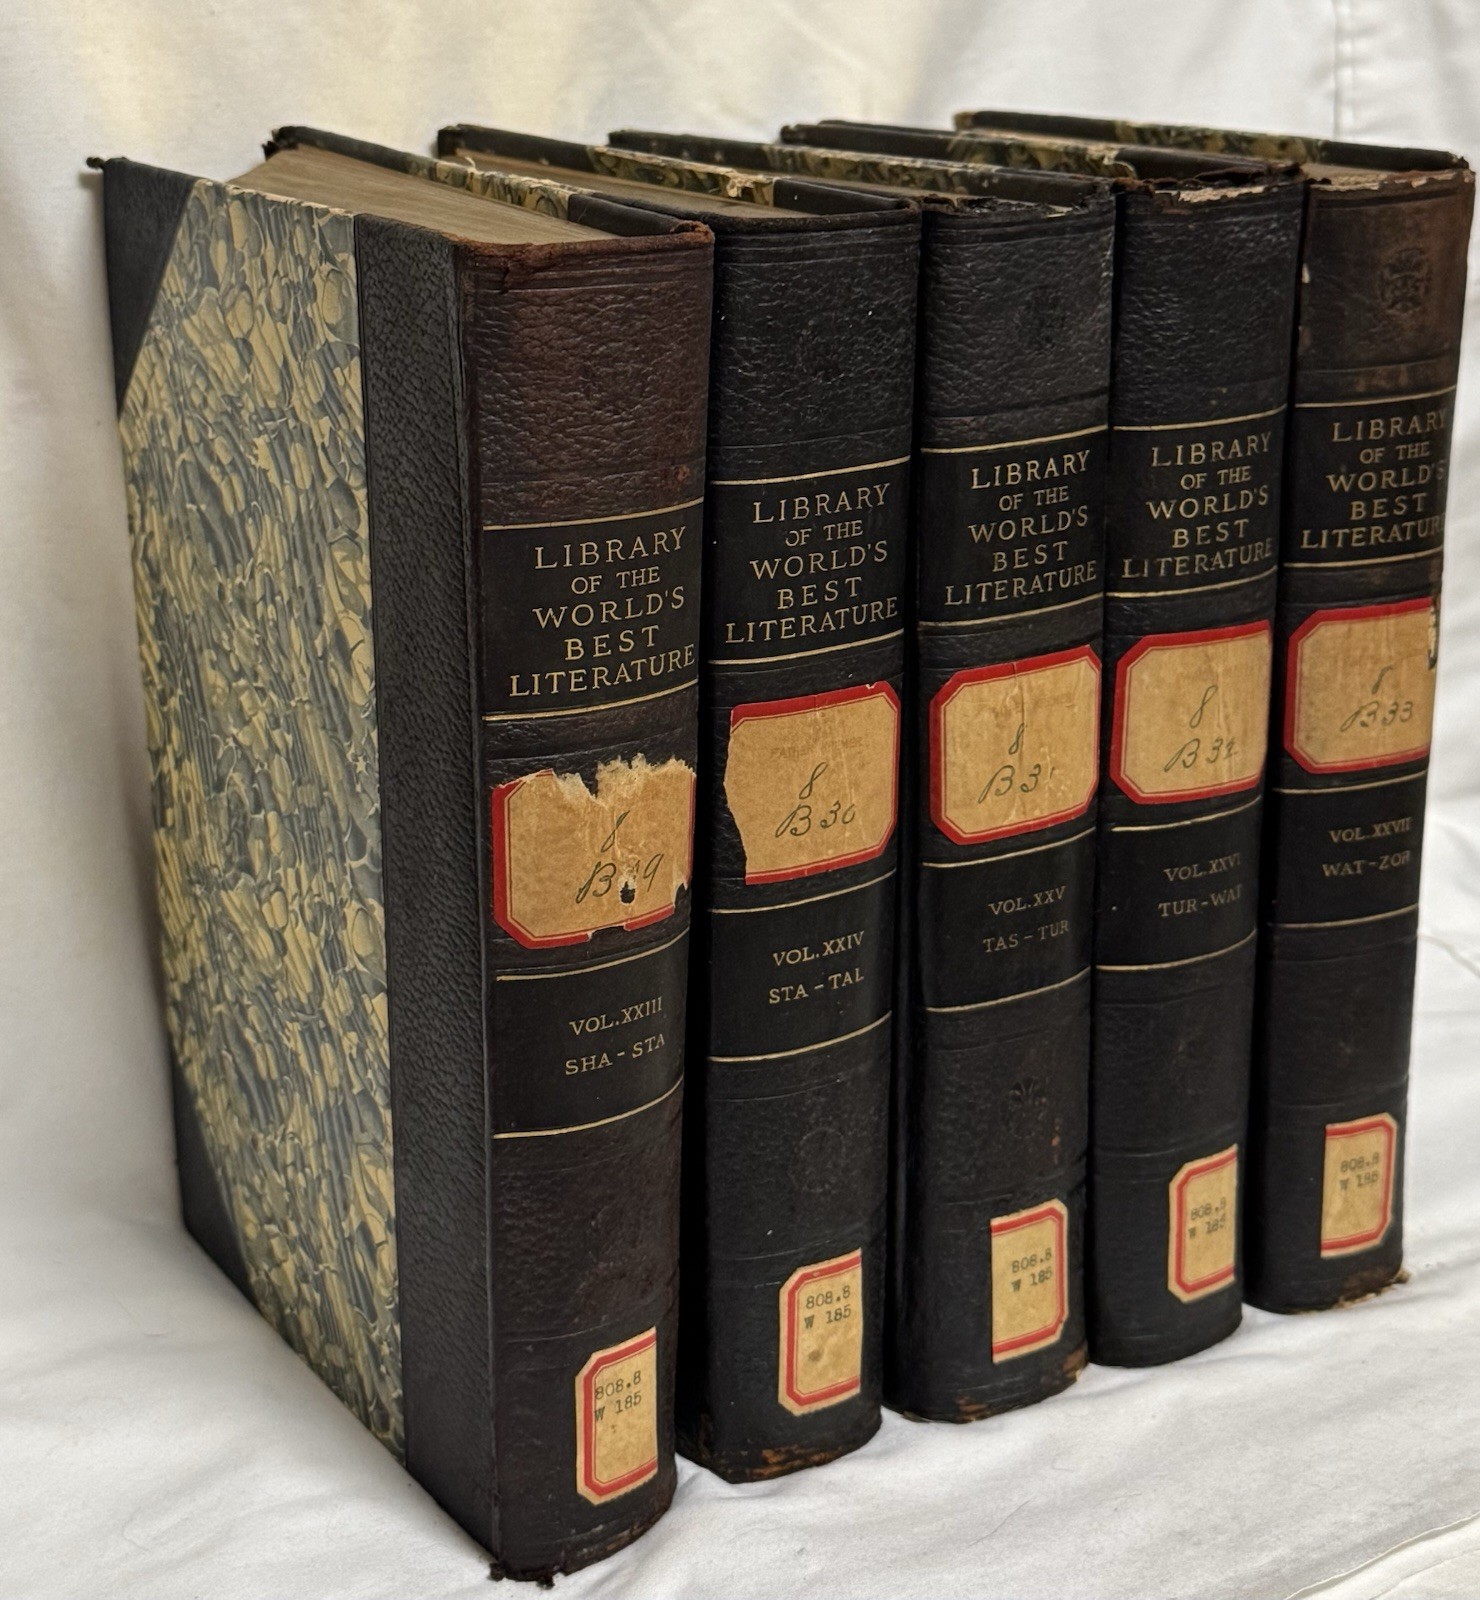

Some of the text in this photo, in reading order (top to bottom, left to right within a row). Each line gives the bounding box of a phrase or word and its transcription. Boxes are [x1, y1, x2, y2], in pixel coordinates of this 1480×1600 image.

[1331, 407, 1449, 443] LIBRARY
[1151, 431, 1272, 467] LIBRARY
[1359, 441, 1431, 465] OF THE
[970, 449, 1090, 490] LIBRARY
[1180, 465, 1252, 490] OF THE
[1326, 459, 1446, 493] WORLD'S
[753, 483, 890, 523] LIBRARY
[999, 485, 1069, 512] OF THE
[1145, 484, 1269, 520] WORLD'S
[1351, 493, 1428, 521] BEST
[785, 520, 863, 547] OF THE
[968, 505, 1088, 544] WORLD'S
[1172, 519, 1250, 549] BEST
[1300, 513, 1444, 549] LITERATUR
[535, 526, 686, 569] LIBRARY
[750, 540, 888, 580] WORLD'S
[992, 540, 1068, 573] BEST
[1121, 537, 1273, 579] LITERATURE
[571, 566, 660, 594] OF THE
[777, 577, 862, 610] BEST
[944, 560, 1097, 606] LITERATURE
[532, 586, 684, 629] WORLD'S
[725, 597, 898, 644] LITERATURE
[564, 625, 659, 660] BEST
[509, 644, 695, 697] LITERATURE
[1188, 684, 1219, 729] 8
[799, 762, 829, 800] 8
[1011, 1247, 1052, 1274] 808.8
[1011, 1266, 1053, 1293] W 185
[805, 1285, 851, 1310] 808.8
[804, 1304, 851, 1330] W 185
[594, 1370, 642, 1400] 808.8
[594, 1391, 643, 1422] W 185
